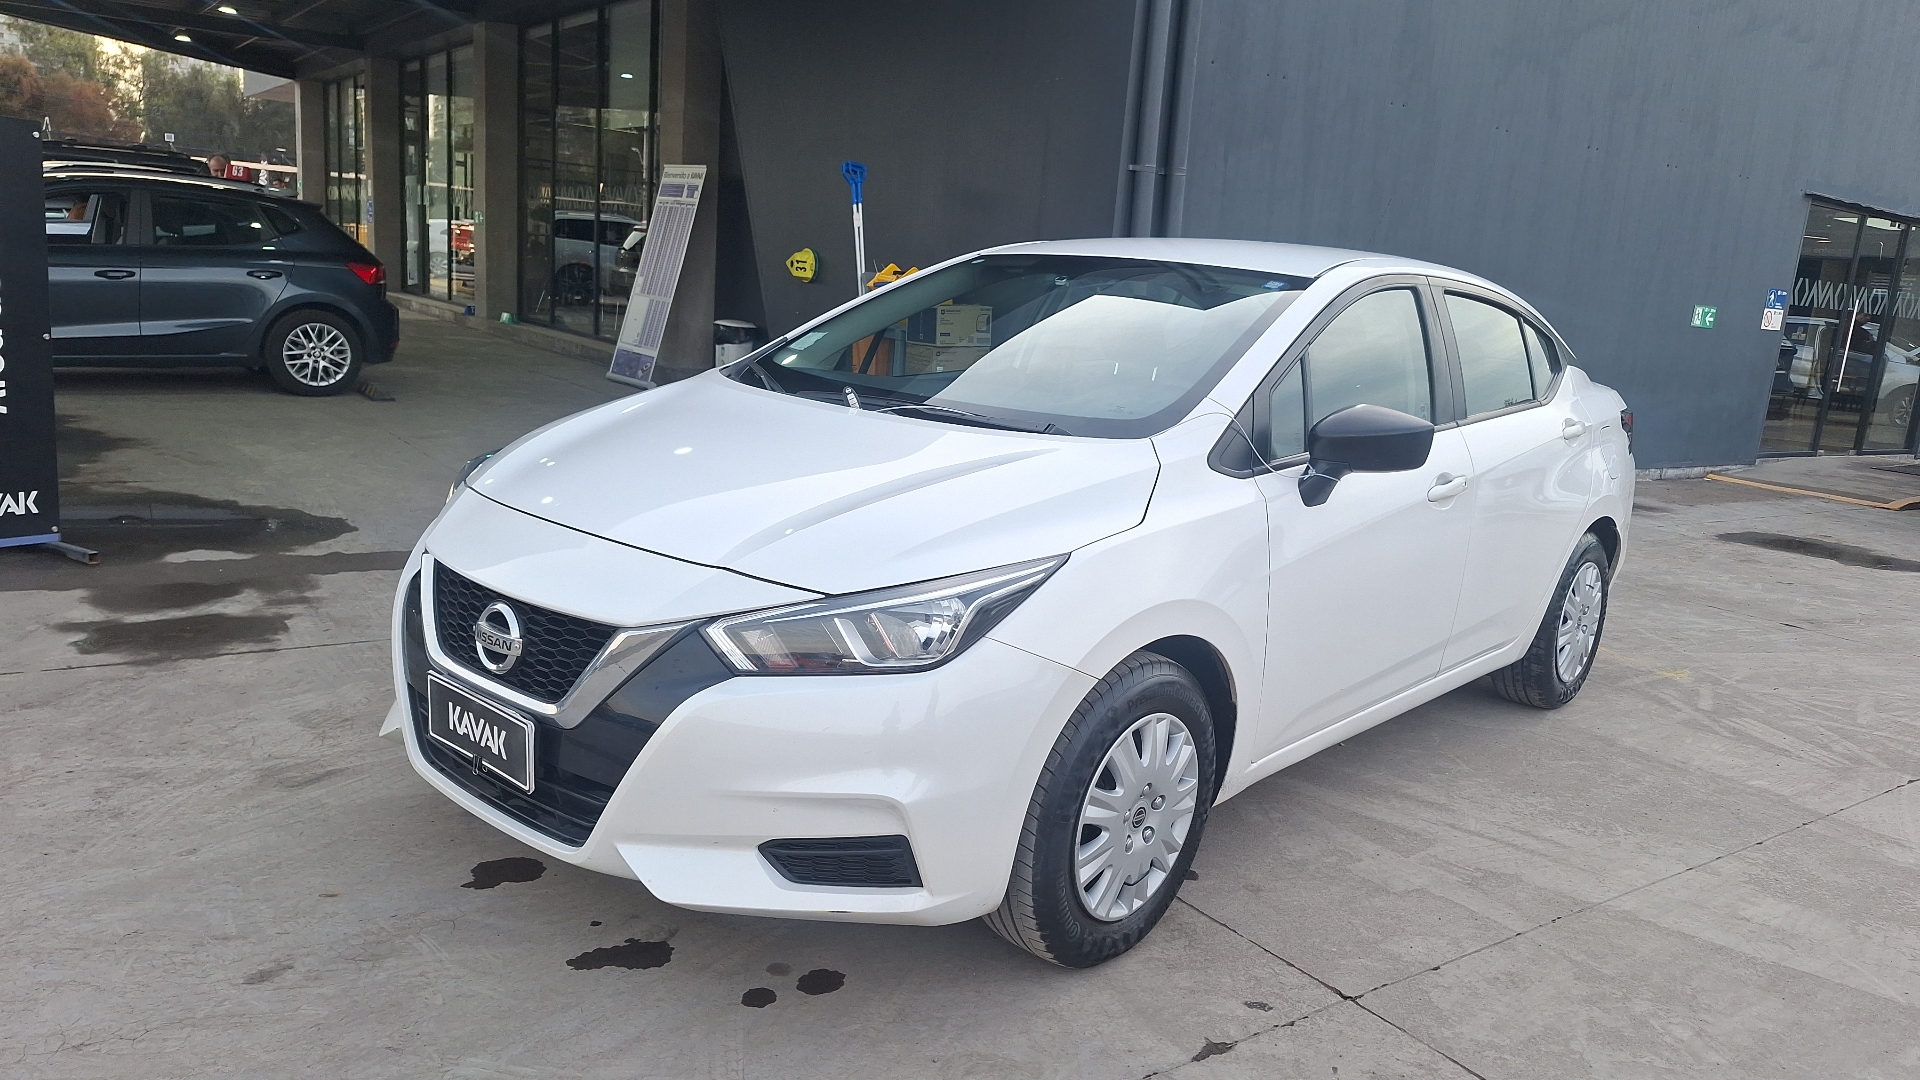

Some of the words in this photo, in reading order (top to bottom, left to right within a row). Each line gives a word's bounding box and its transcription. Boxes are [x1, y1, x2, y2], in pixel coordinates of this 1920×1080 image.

[795, 259, 808, 272] 31
[0, 490, 40, 517] AK
[448, 701, 508, 761] KAVAK
